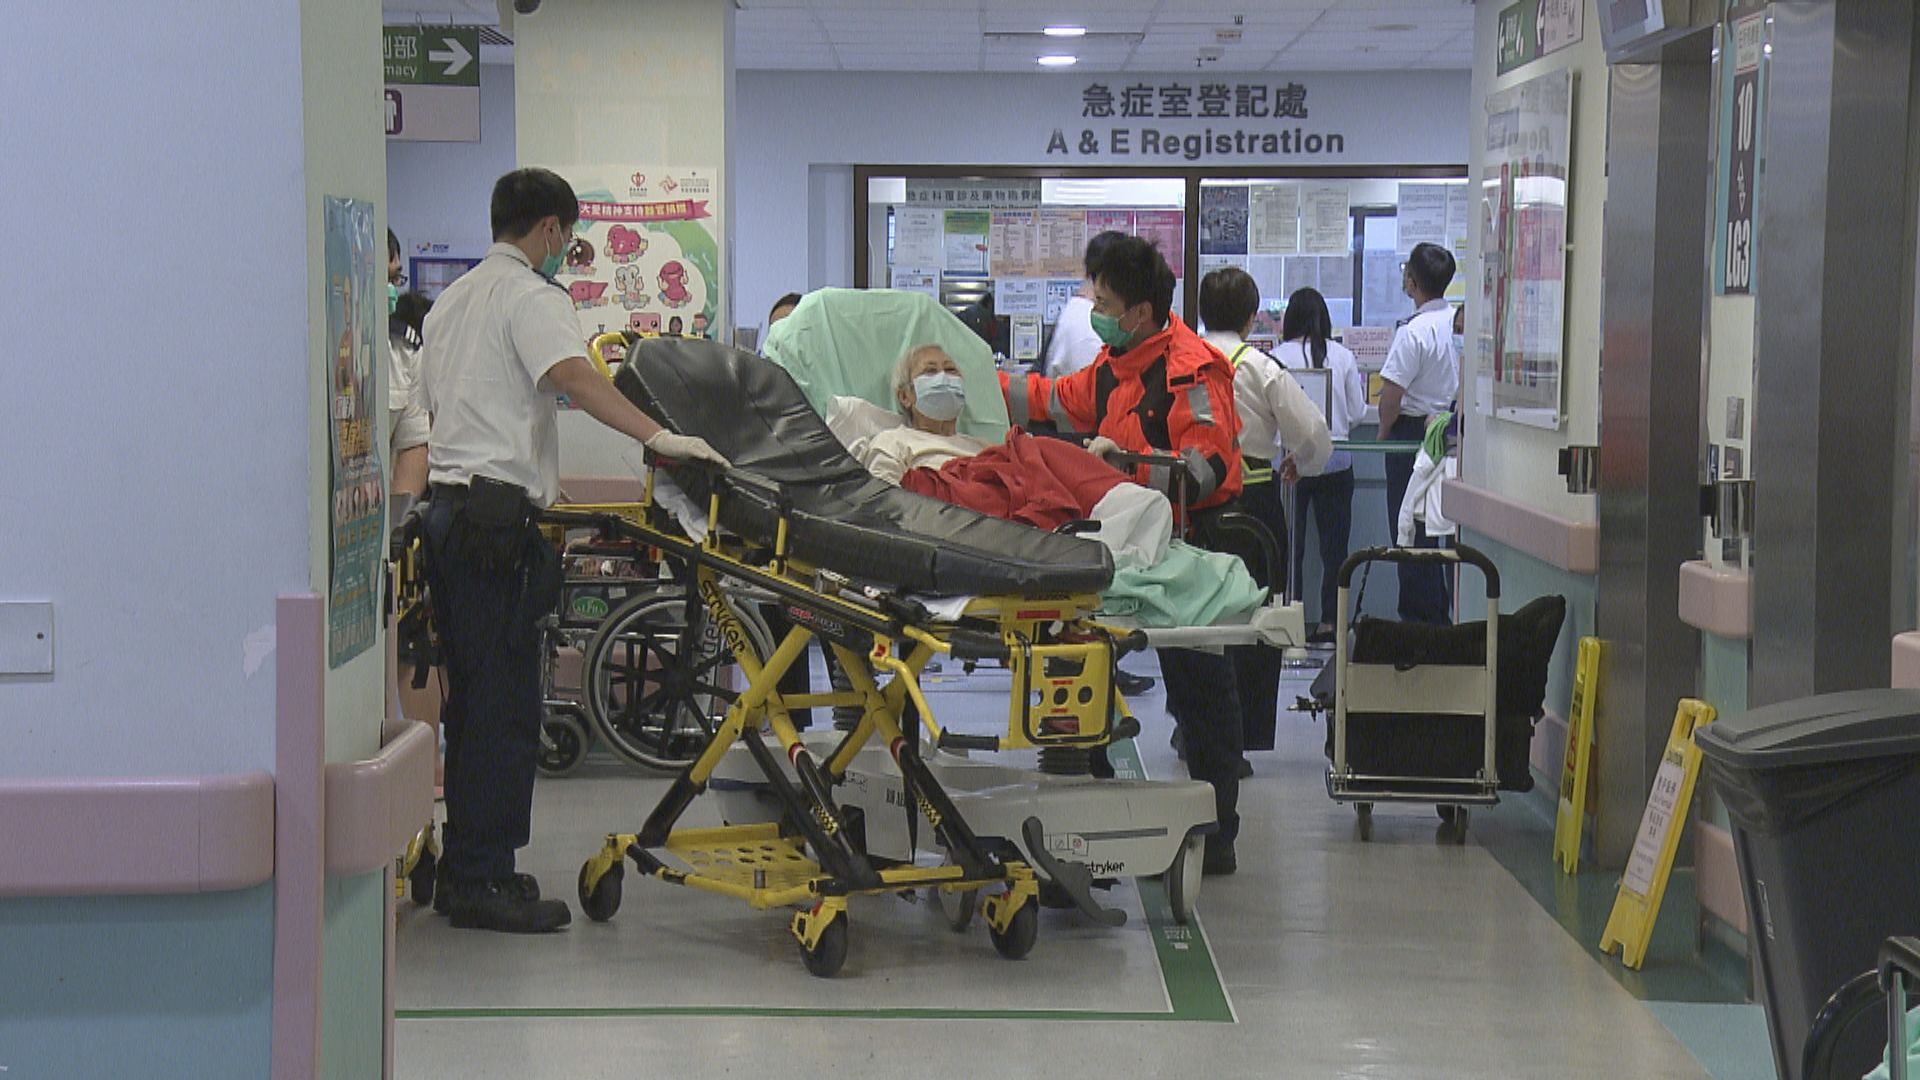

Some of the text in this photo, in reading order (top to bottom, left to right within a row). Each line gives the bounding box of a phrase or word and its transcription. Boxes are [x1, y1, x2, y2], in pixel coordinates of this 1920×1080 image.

[1082, 83, 1308, 119] 急症室登記處
[1737, 82, 1753, 151] 10
[1046, 128, 1344, 161] A & E Registration
[1725, 219, 1750, 288] LG3
[702, 580, 746, 653] stryker
